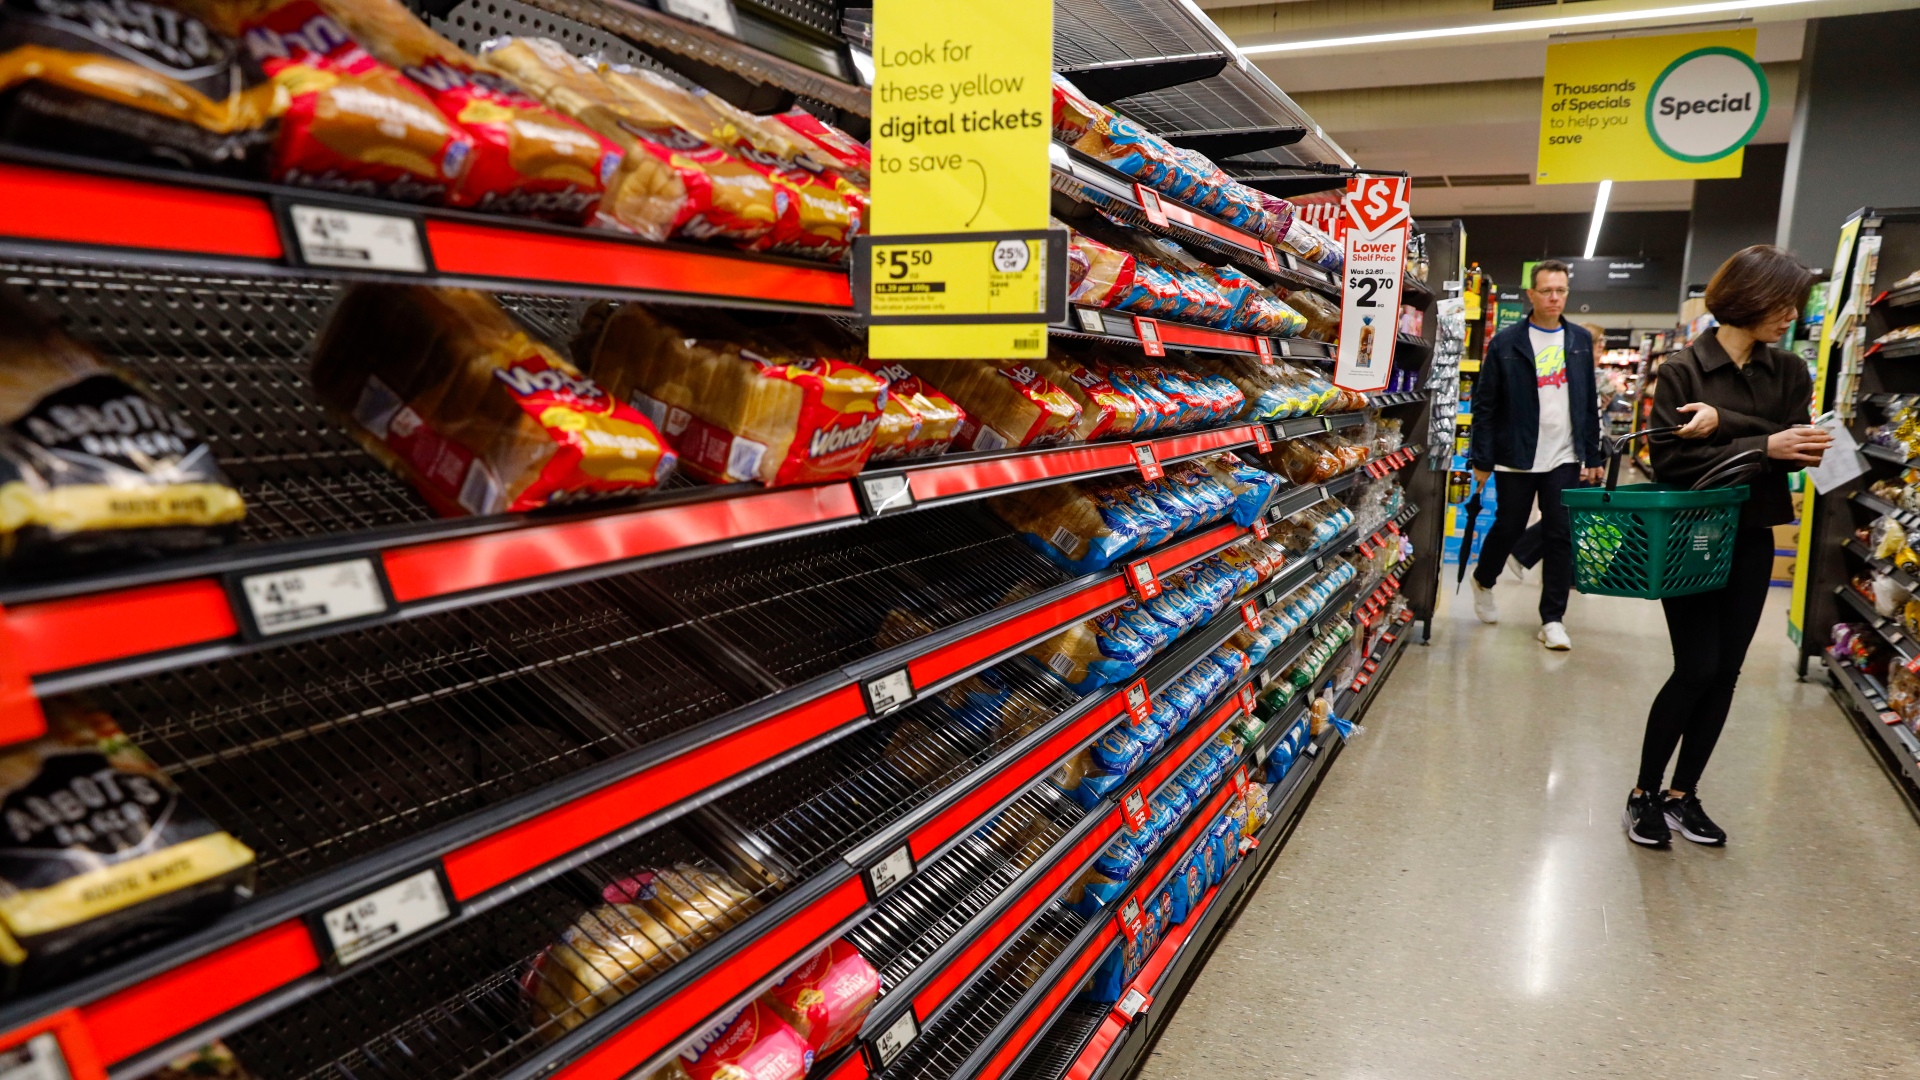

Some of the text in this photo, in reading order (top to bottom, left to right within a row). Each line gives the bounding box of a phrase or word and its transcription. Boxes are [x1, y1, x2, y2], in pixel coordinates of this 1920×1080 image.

[881, 40, 973, 68] Look for
[879, 74, 1024, 104] these yellow
[1553, 79, 1636, 97] Thousands
[1551, 96, 1631, 113] of Specials
[1659, 93, 1752, 120] Special
[880, 109, 1043, 142] digital tickets
[1550, 114, 1628, 130] to help you
[1549, 134, 1583, 146] save
[879, 153, 962, 174] to save
[998, 248, 1024, 260] 25%
[1353, 240, 1396, 253] Lower
[809, 413, 882, 459] Wonder
